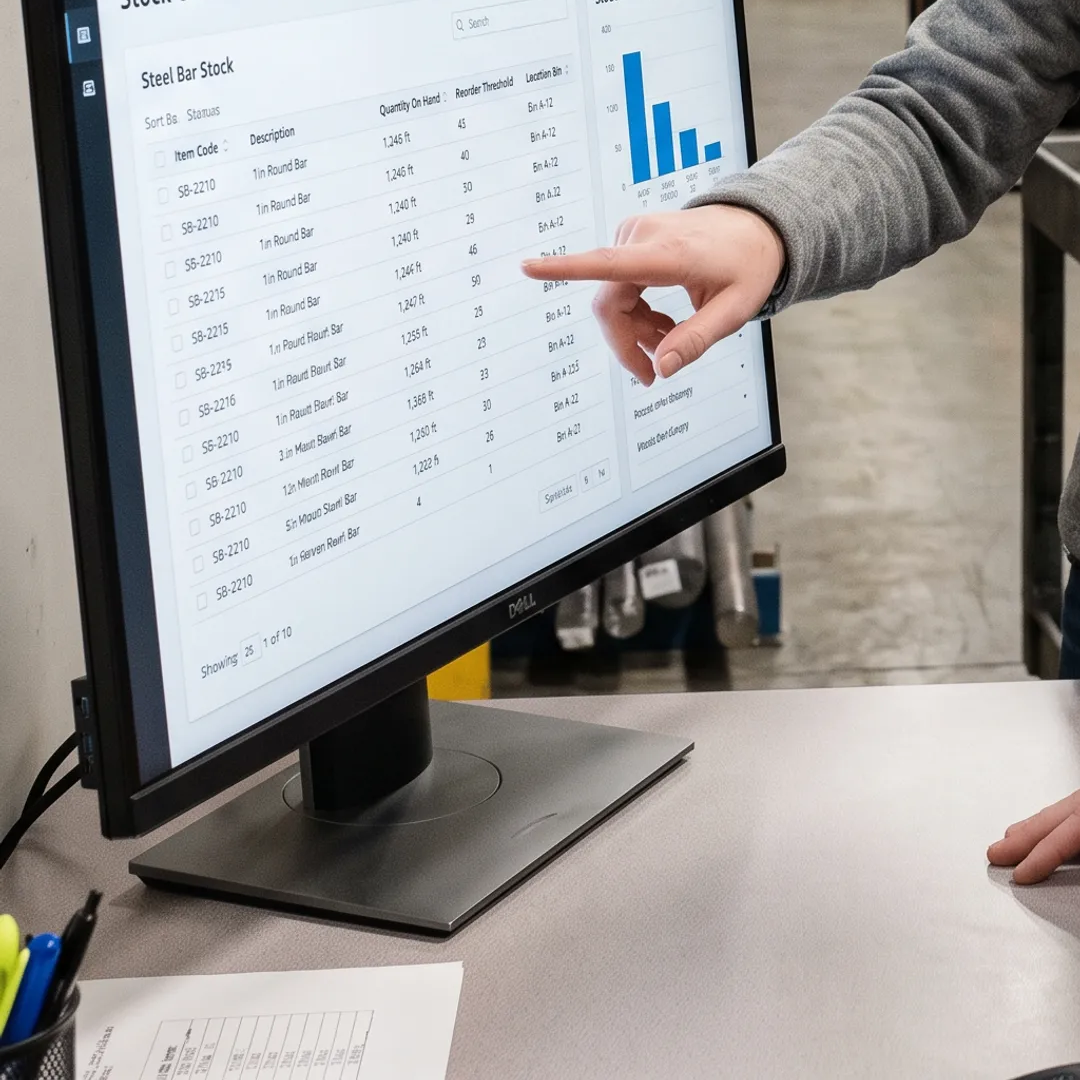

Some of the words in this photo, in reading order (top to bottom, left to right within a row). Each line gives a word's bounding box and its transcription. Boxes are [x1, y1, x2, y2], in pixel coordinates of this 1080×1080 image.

[141, 67, 174, 89] Steel
[177, 65, 197, 82] Bar
[200, 56, 234, 78] Stock
[455, 85, 481, 99] Reorder
[379, 100, 410, 117] Quantity
[411, 98, 422, 109] On
[423, 92, 441, 106] Hand
[144, 115, 164, 130] Sort
[250, 126, 295, 146] Description
[174, 149, 195, 162] Item
[197, 142, 218, 157] Code
[267, 160, 293, 177] Round
[295, 157, 308, 170] Bar
[408, 163, 414, 176] ft
[256, 203, 269, 216] 1in
[298, 192, 311, 205] Bar
[389, 199, 409, 214] 1,240
[411, 196, 417, 208] ft
[273, 230, 299, 246] Round
[300, 226, 314, 239] Bar
[277, 264, 303, 282] Round
[304, 261, 317, 274] Bar
[307, 295, 321, 308] Bar
[338, 424, 352, 437] Bar
[342, 459, 355, 472] Bar
[347, 526, 360, 540] Bar
[263, 637, 268, 648] 1
[270, 632, 279, 645] of
[282, 626, 292, 638] 10
[244, 645, 254, 658] 25
[201, 652, 238, 679] Showing
